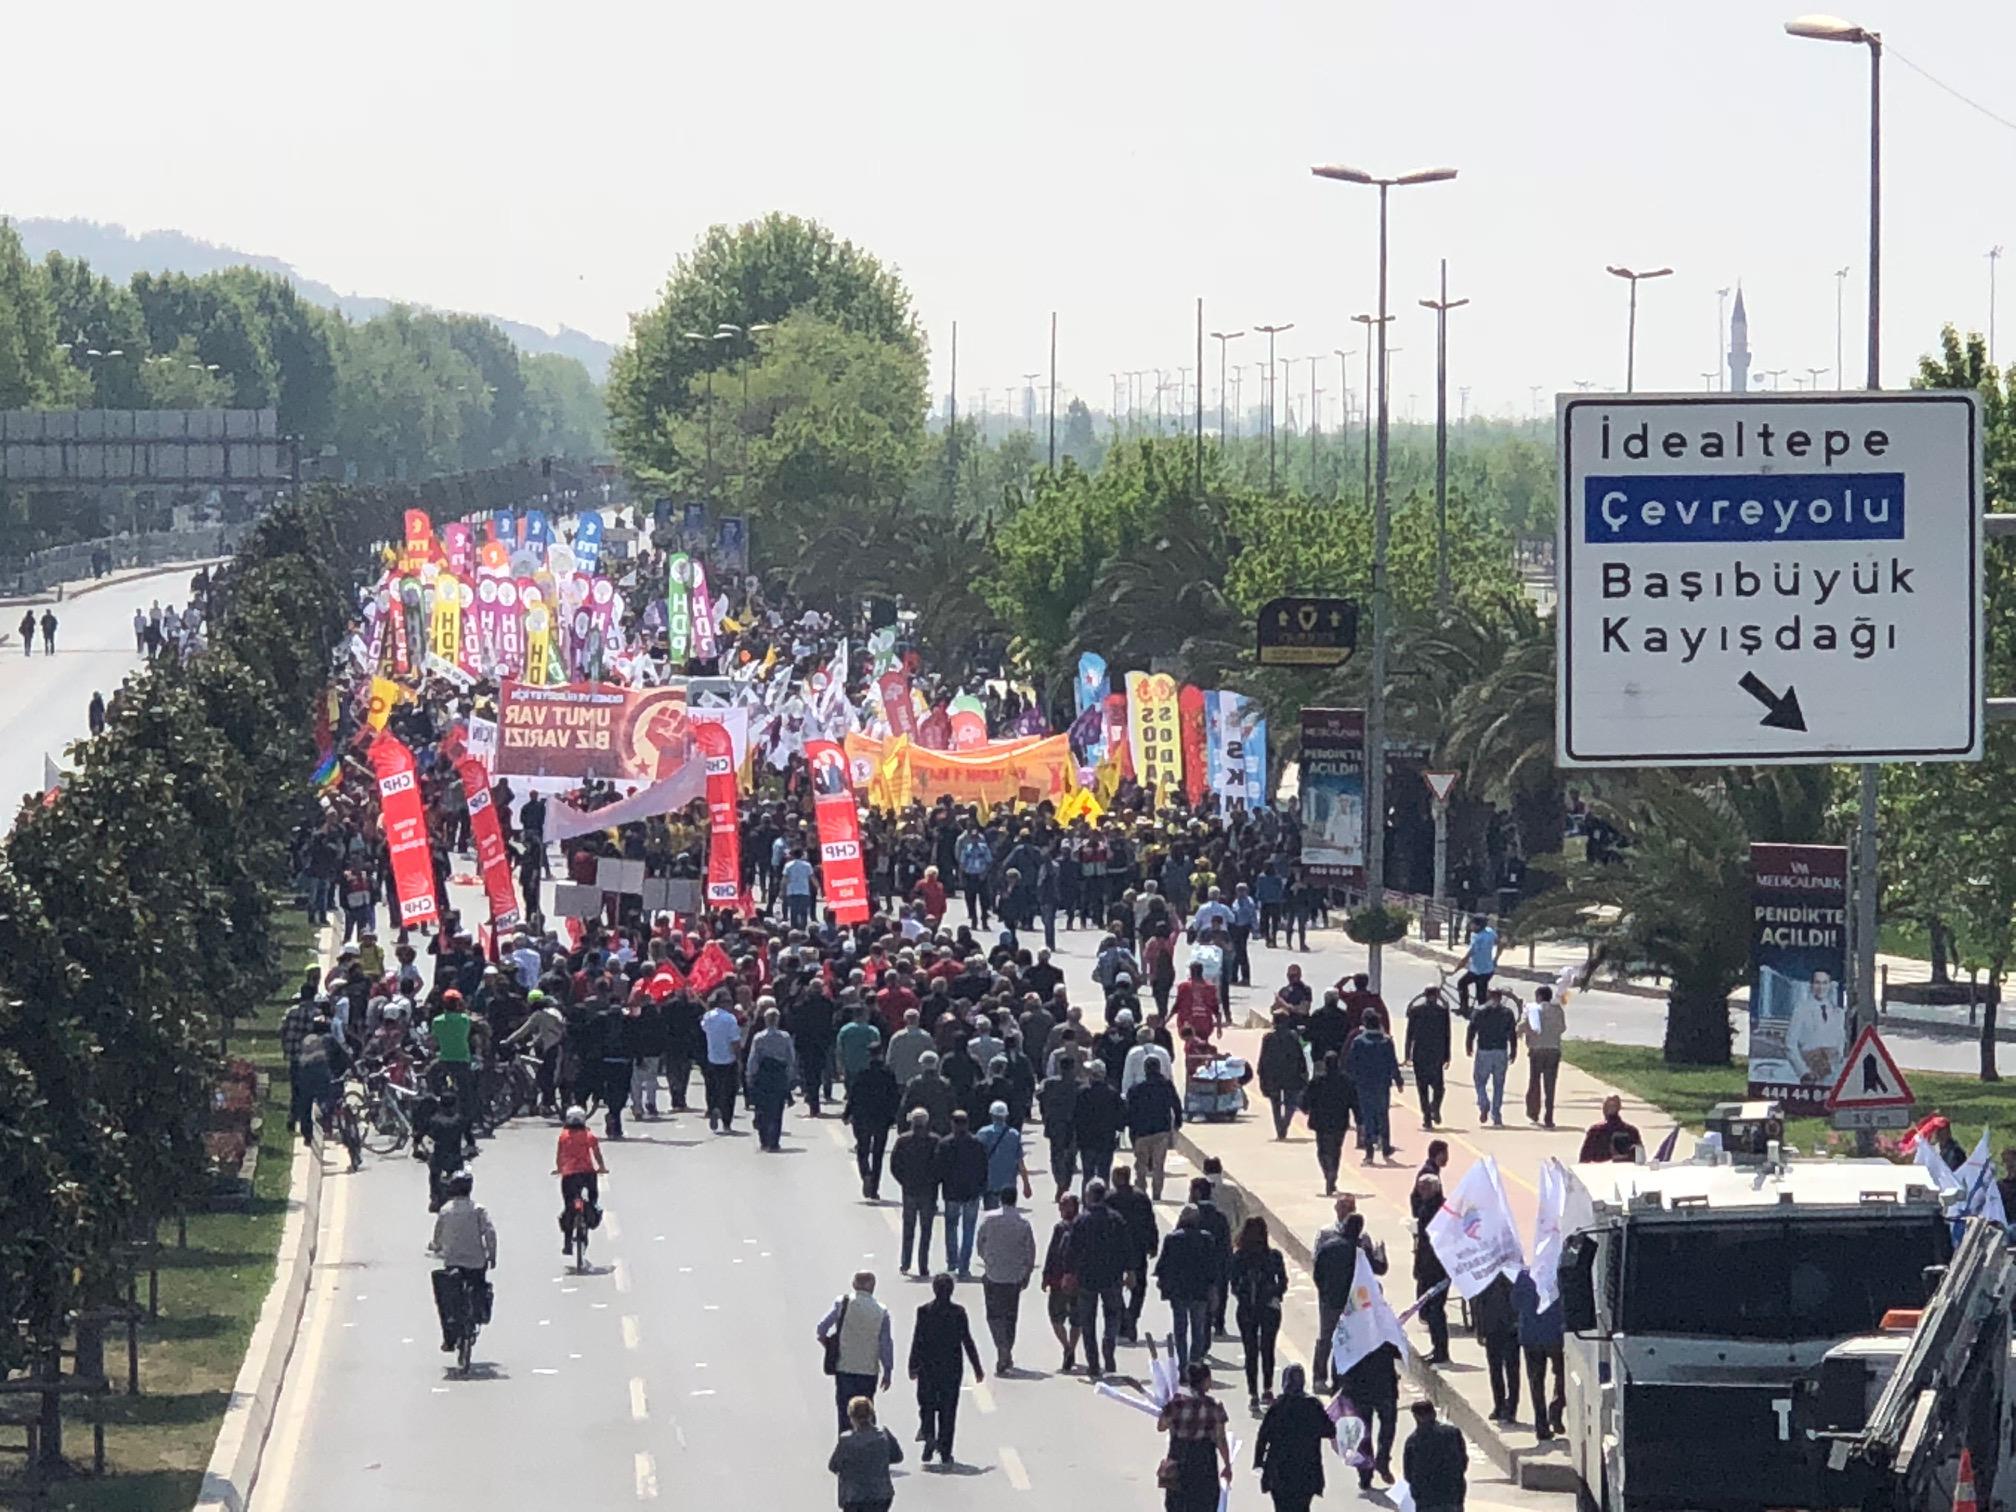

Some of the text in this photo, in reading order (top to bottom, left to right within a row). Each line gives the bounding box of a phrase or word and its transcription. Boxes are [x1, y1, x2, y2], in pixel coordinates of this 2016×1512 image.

[1601, 415, 1890, 467] İdealtepe
[1601, 489, 1890, 534] Çevreyolu
[1602, 558, 1915, 605] Başıbüyük
[1602, 614, 1896, 663] Kayışdağı
[1755, 905, 1844, 924] PENDİK'TE
[1760, 927, 1837, 949] AÇILDI!
